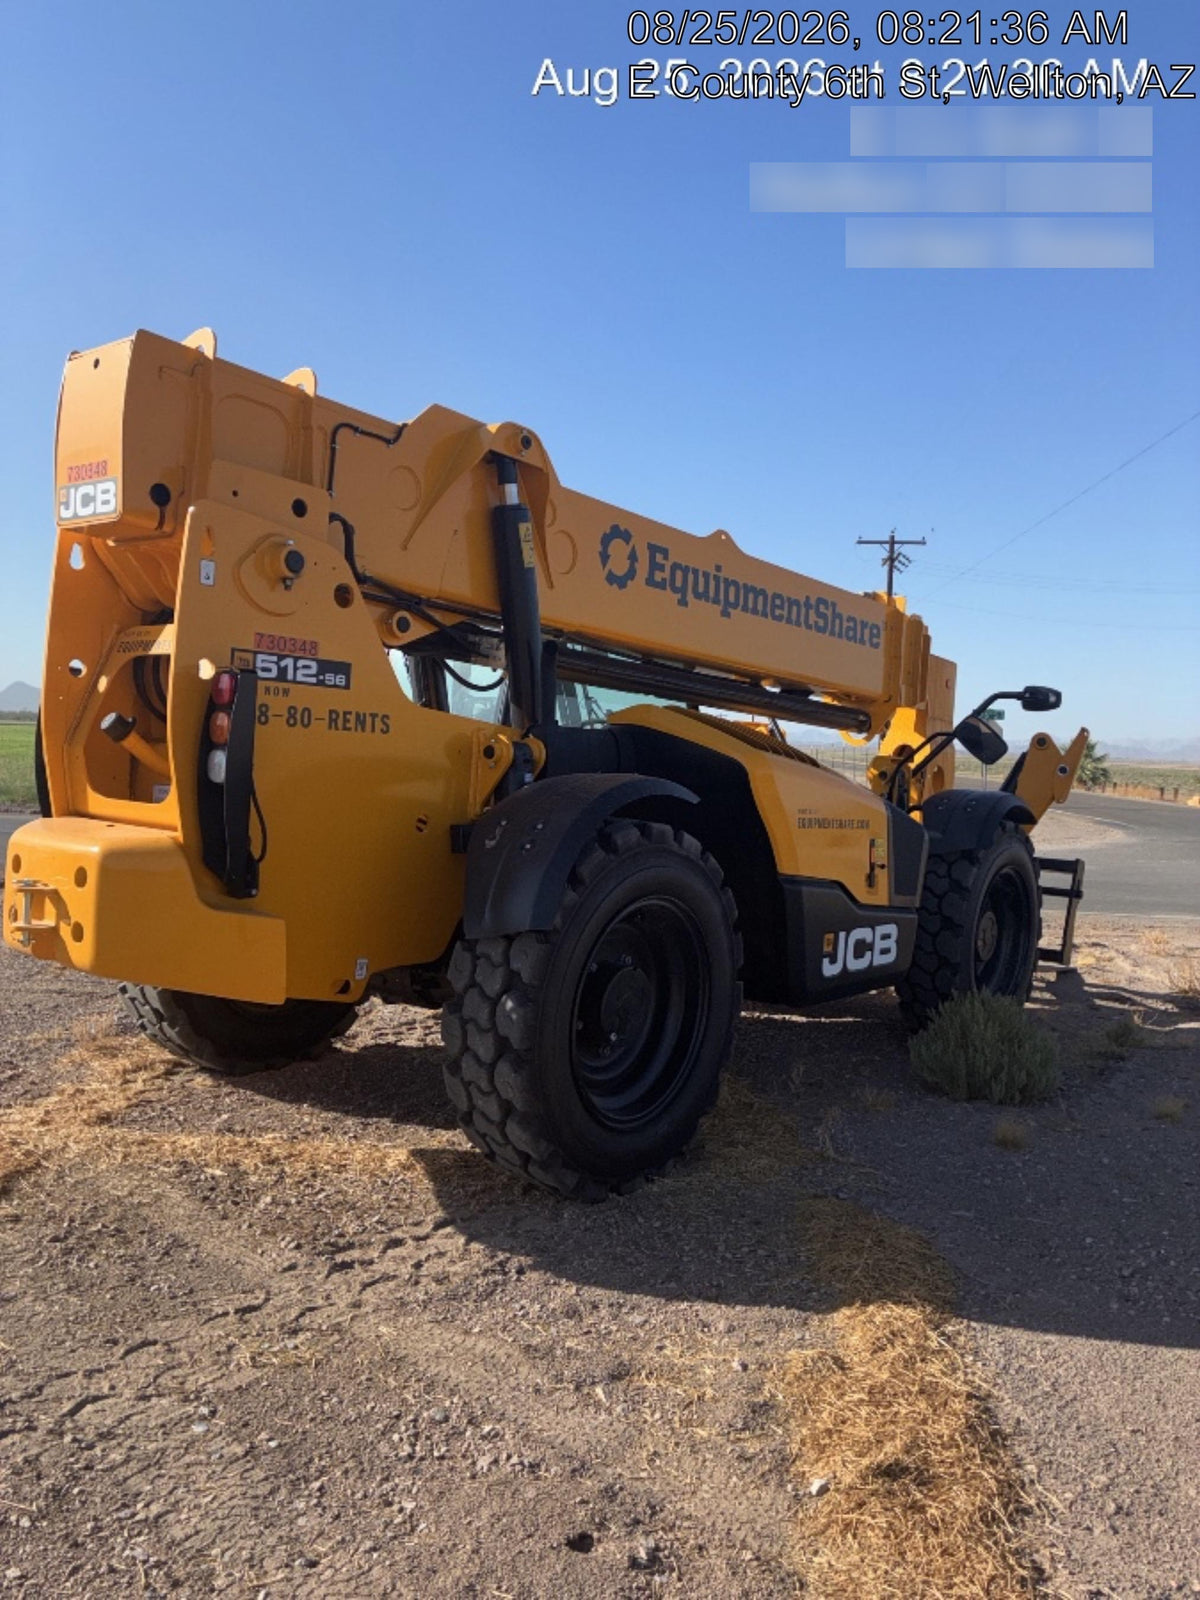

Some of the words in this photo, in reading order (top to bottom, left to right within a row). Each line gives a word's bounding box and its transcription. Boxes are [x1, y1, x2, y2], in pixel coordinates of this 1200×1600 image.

[60, 480, 116, 519] JCB
[645, 541, 882, 649] EquipmentShare
[254, 631, 319, 657] 730348
[264, 685, 290, 698] NOW
[821, 923, 898, 977] JCB
